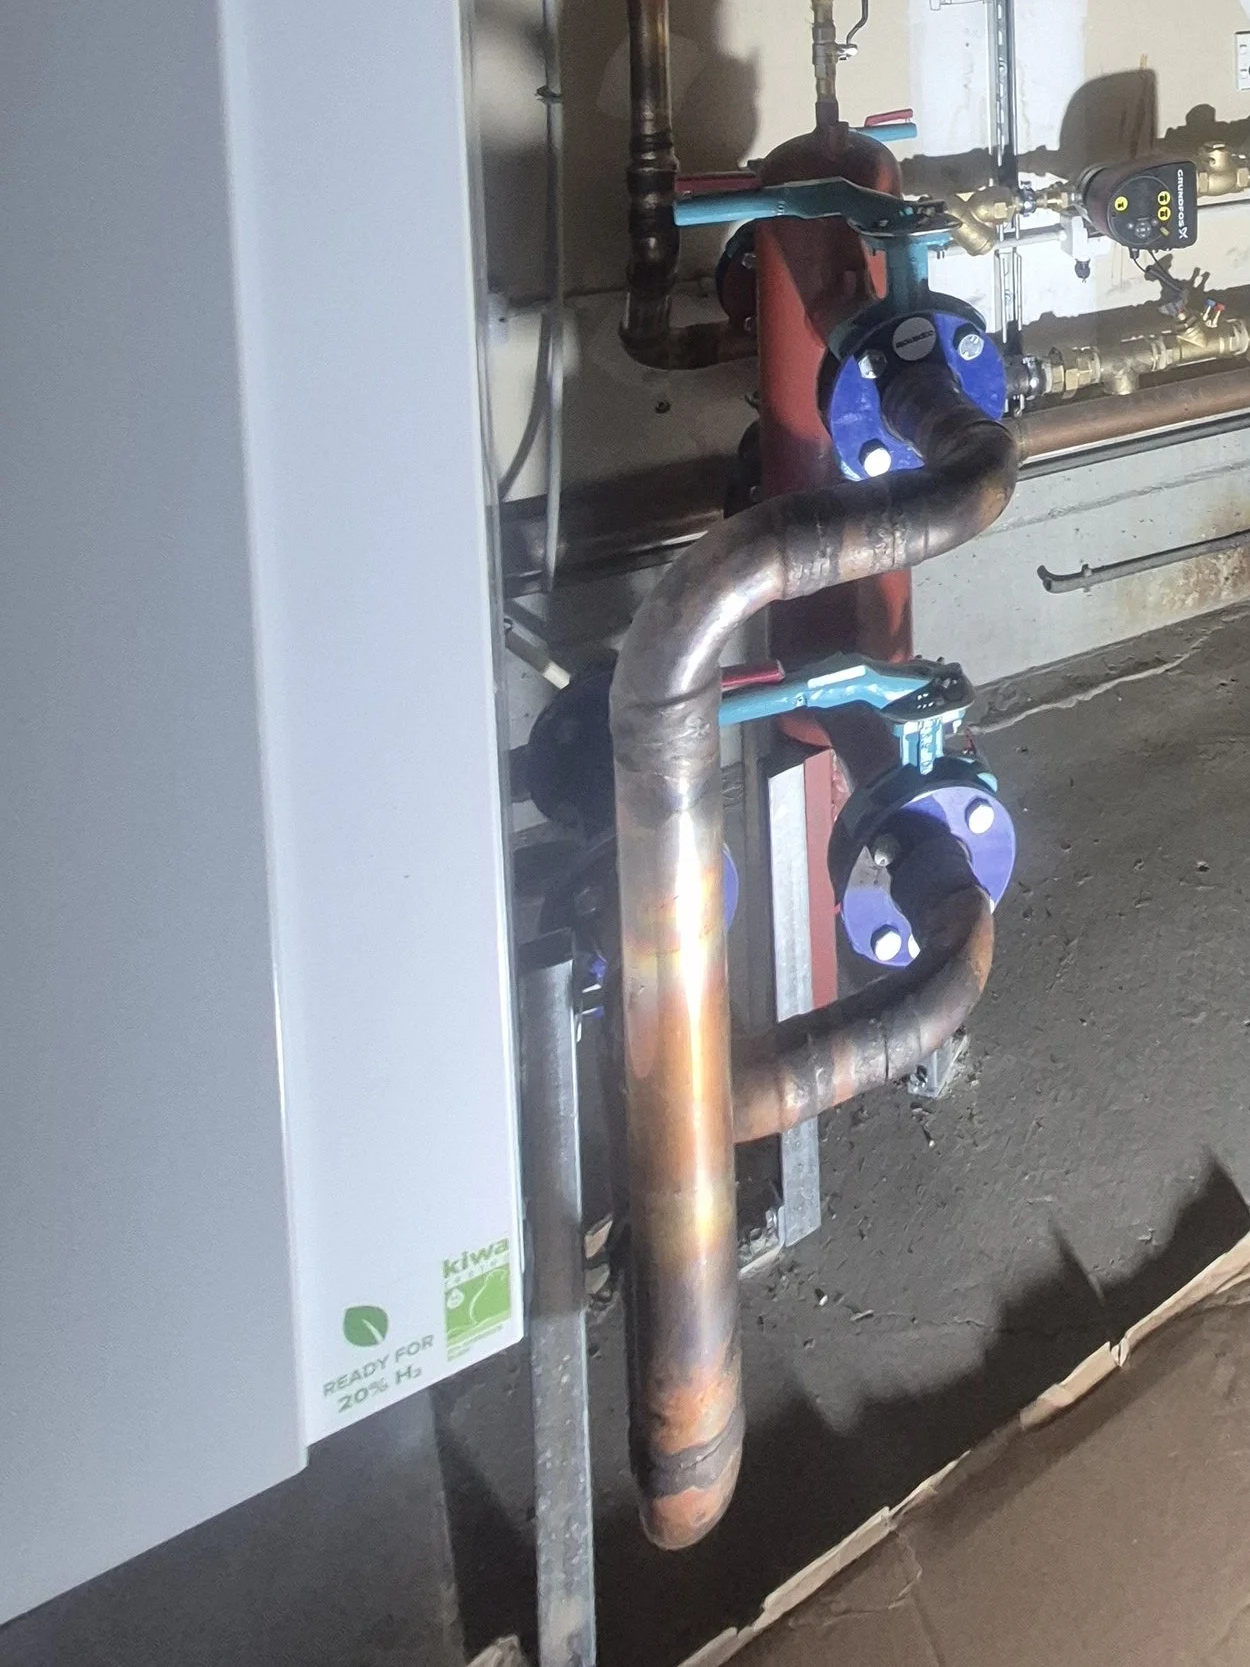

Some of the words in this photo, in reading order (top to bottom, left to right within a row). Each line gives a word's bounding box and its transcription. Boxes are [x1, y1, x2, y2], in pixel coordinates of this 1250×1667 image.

[1177, 168, 1185, 227] GRUNDFOS
[443, 1237, 510, 1278] kiwa
[322, 1354, 390, 1397] READY
[394, 1334, 434, 1363] FOR
[338, 1377, 389, 1414] 20%
